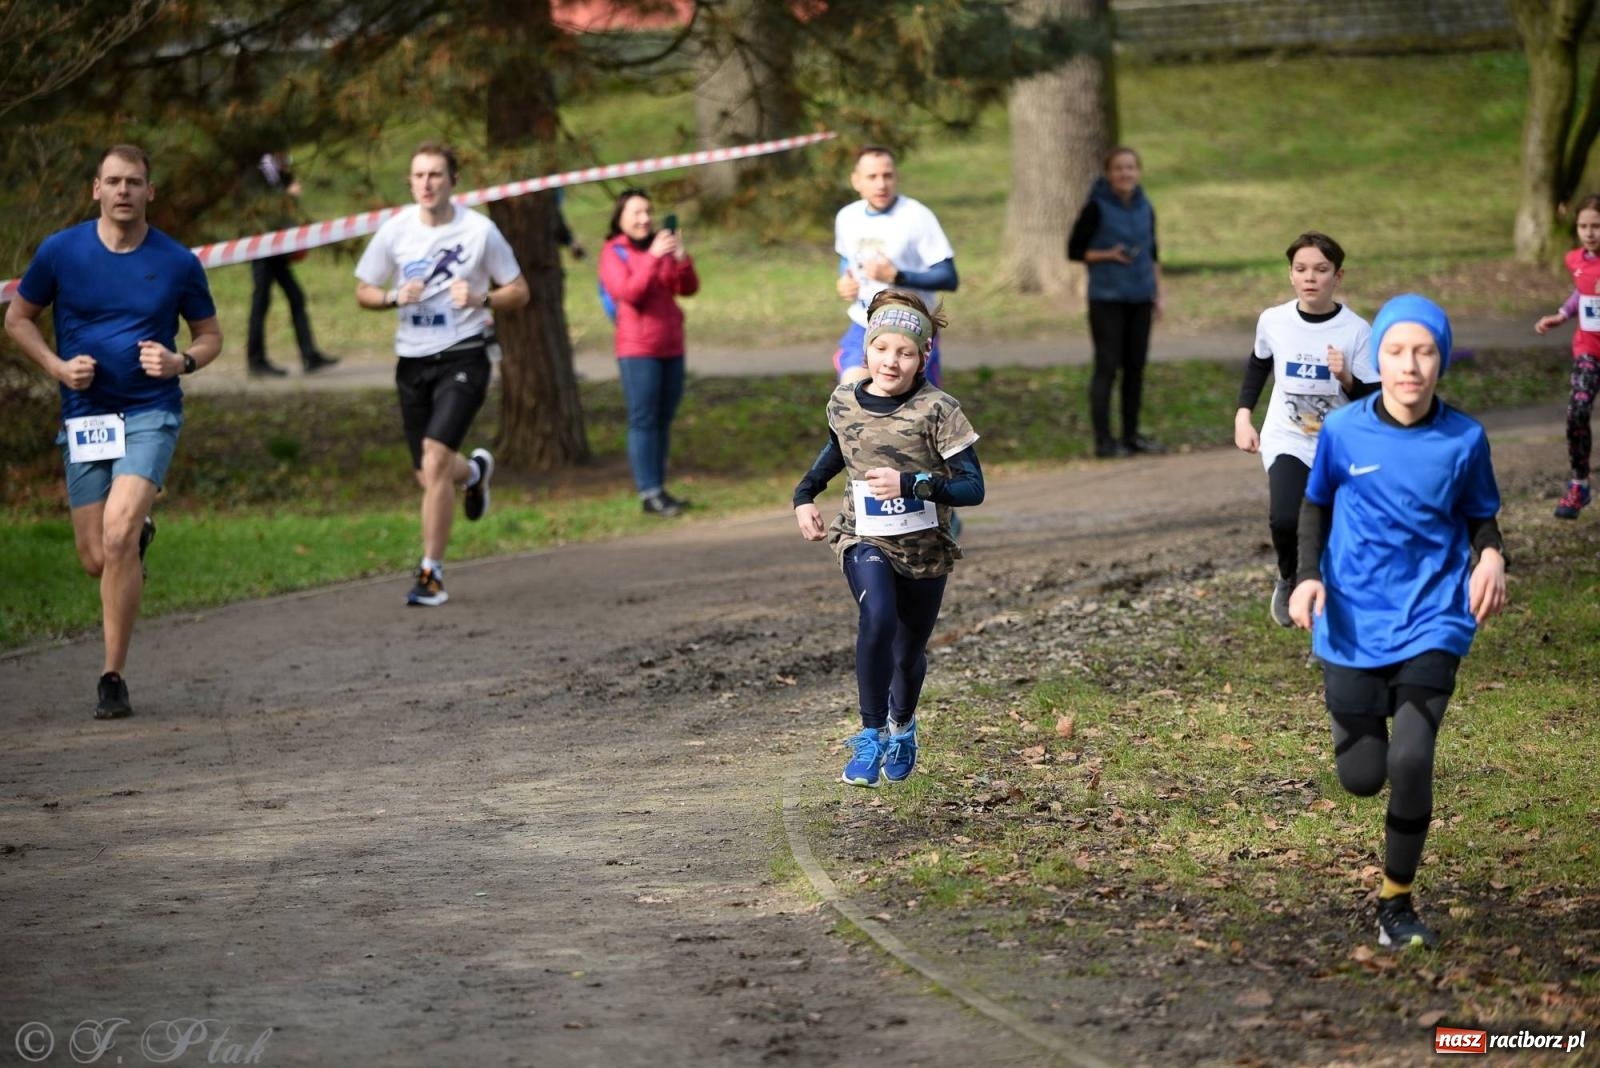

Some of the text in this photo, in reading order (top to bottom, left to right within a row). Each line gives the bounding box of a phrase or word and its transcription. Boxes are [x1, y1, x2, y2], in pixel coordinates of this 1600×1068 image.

[1297, 364, 1317, 379] 44
[83, 428, 109, 445] 140
[880, 497, 906, 515] 48
